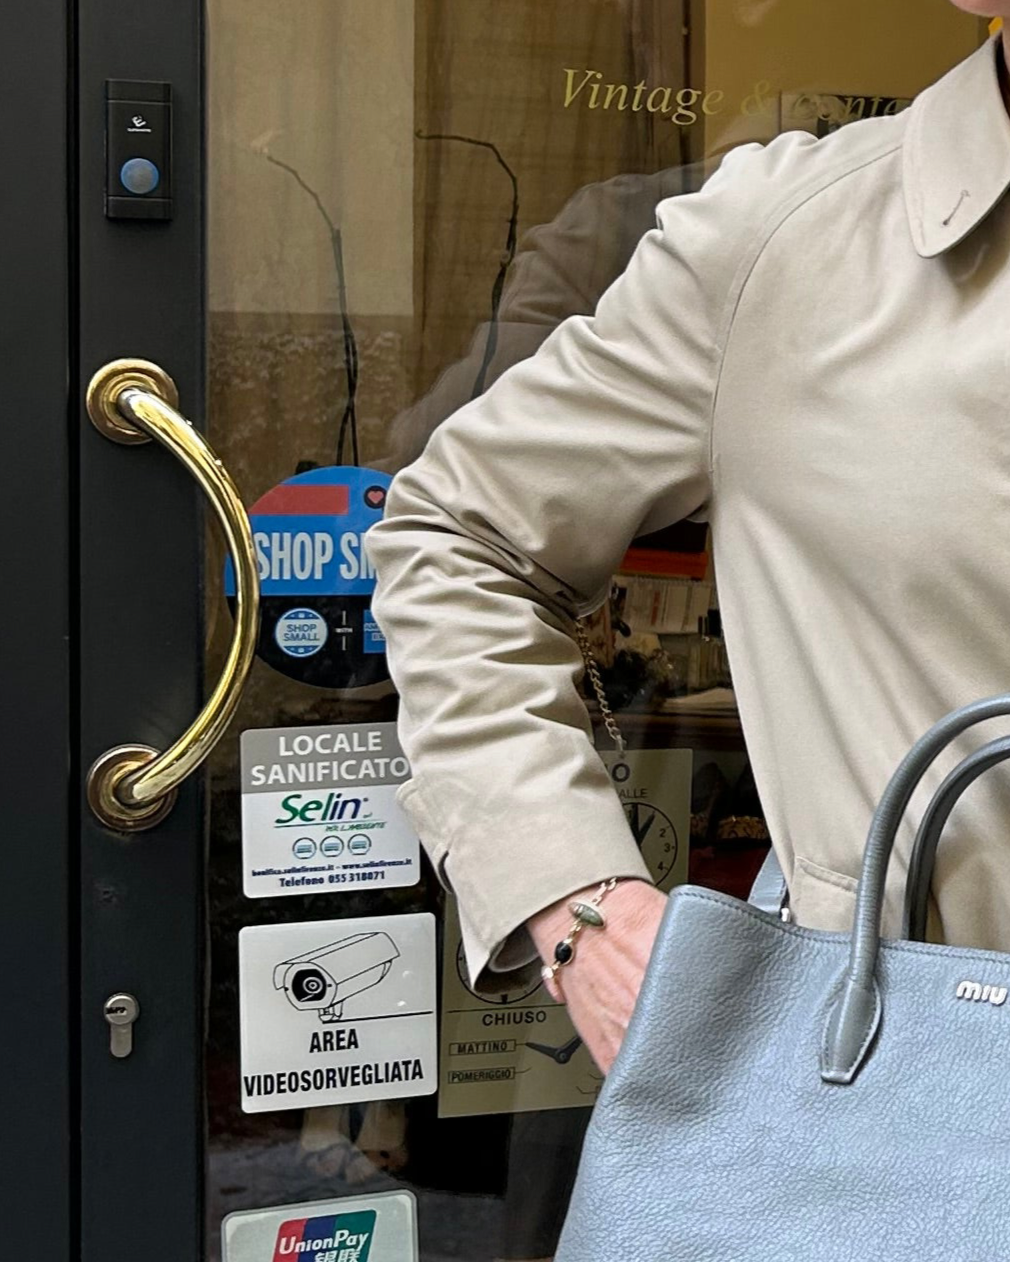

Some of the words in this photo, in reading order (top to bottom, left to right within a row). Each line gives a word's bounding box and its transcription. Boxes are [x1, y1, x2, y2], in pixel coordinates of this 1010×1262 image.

[561, 68, 724, 125] Vintage
[253, 532, 334, 580] SHOP
[283, 632, 320, 642] SMALL
[286, 623, 317, 633] SHOP
[280, 732, 382, 756] LOCALE
[252, 758, 408, 785] SANIFICATO
[274, 792, 362, 825] Selin
[279, 876, 325, 887] Telefono
[328, 873, 346, 884] 055
[482, 1010, 547, 1026] CHIUSO
[309, 1028, 359, 1053] AREA
[458, 1041, 508, 1054] MATTINO
[244, 1059, 424, 1097] VIDEOSORVEGLIATA
[451, 1069, 511, 1082] POMERIGGIO
[279, 1229, 369, 1255] UnionPay
